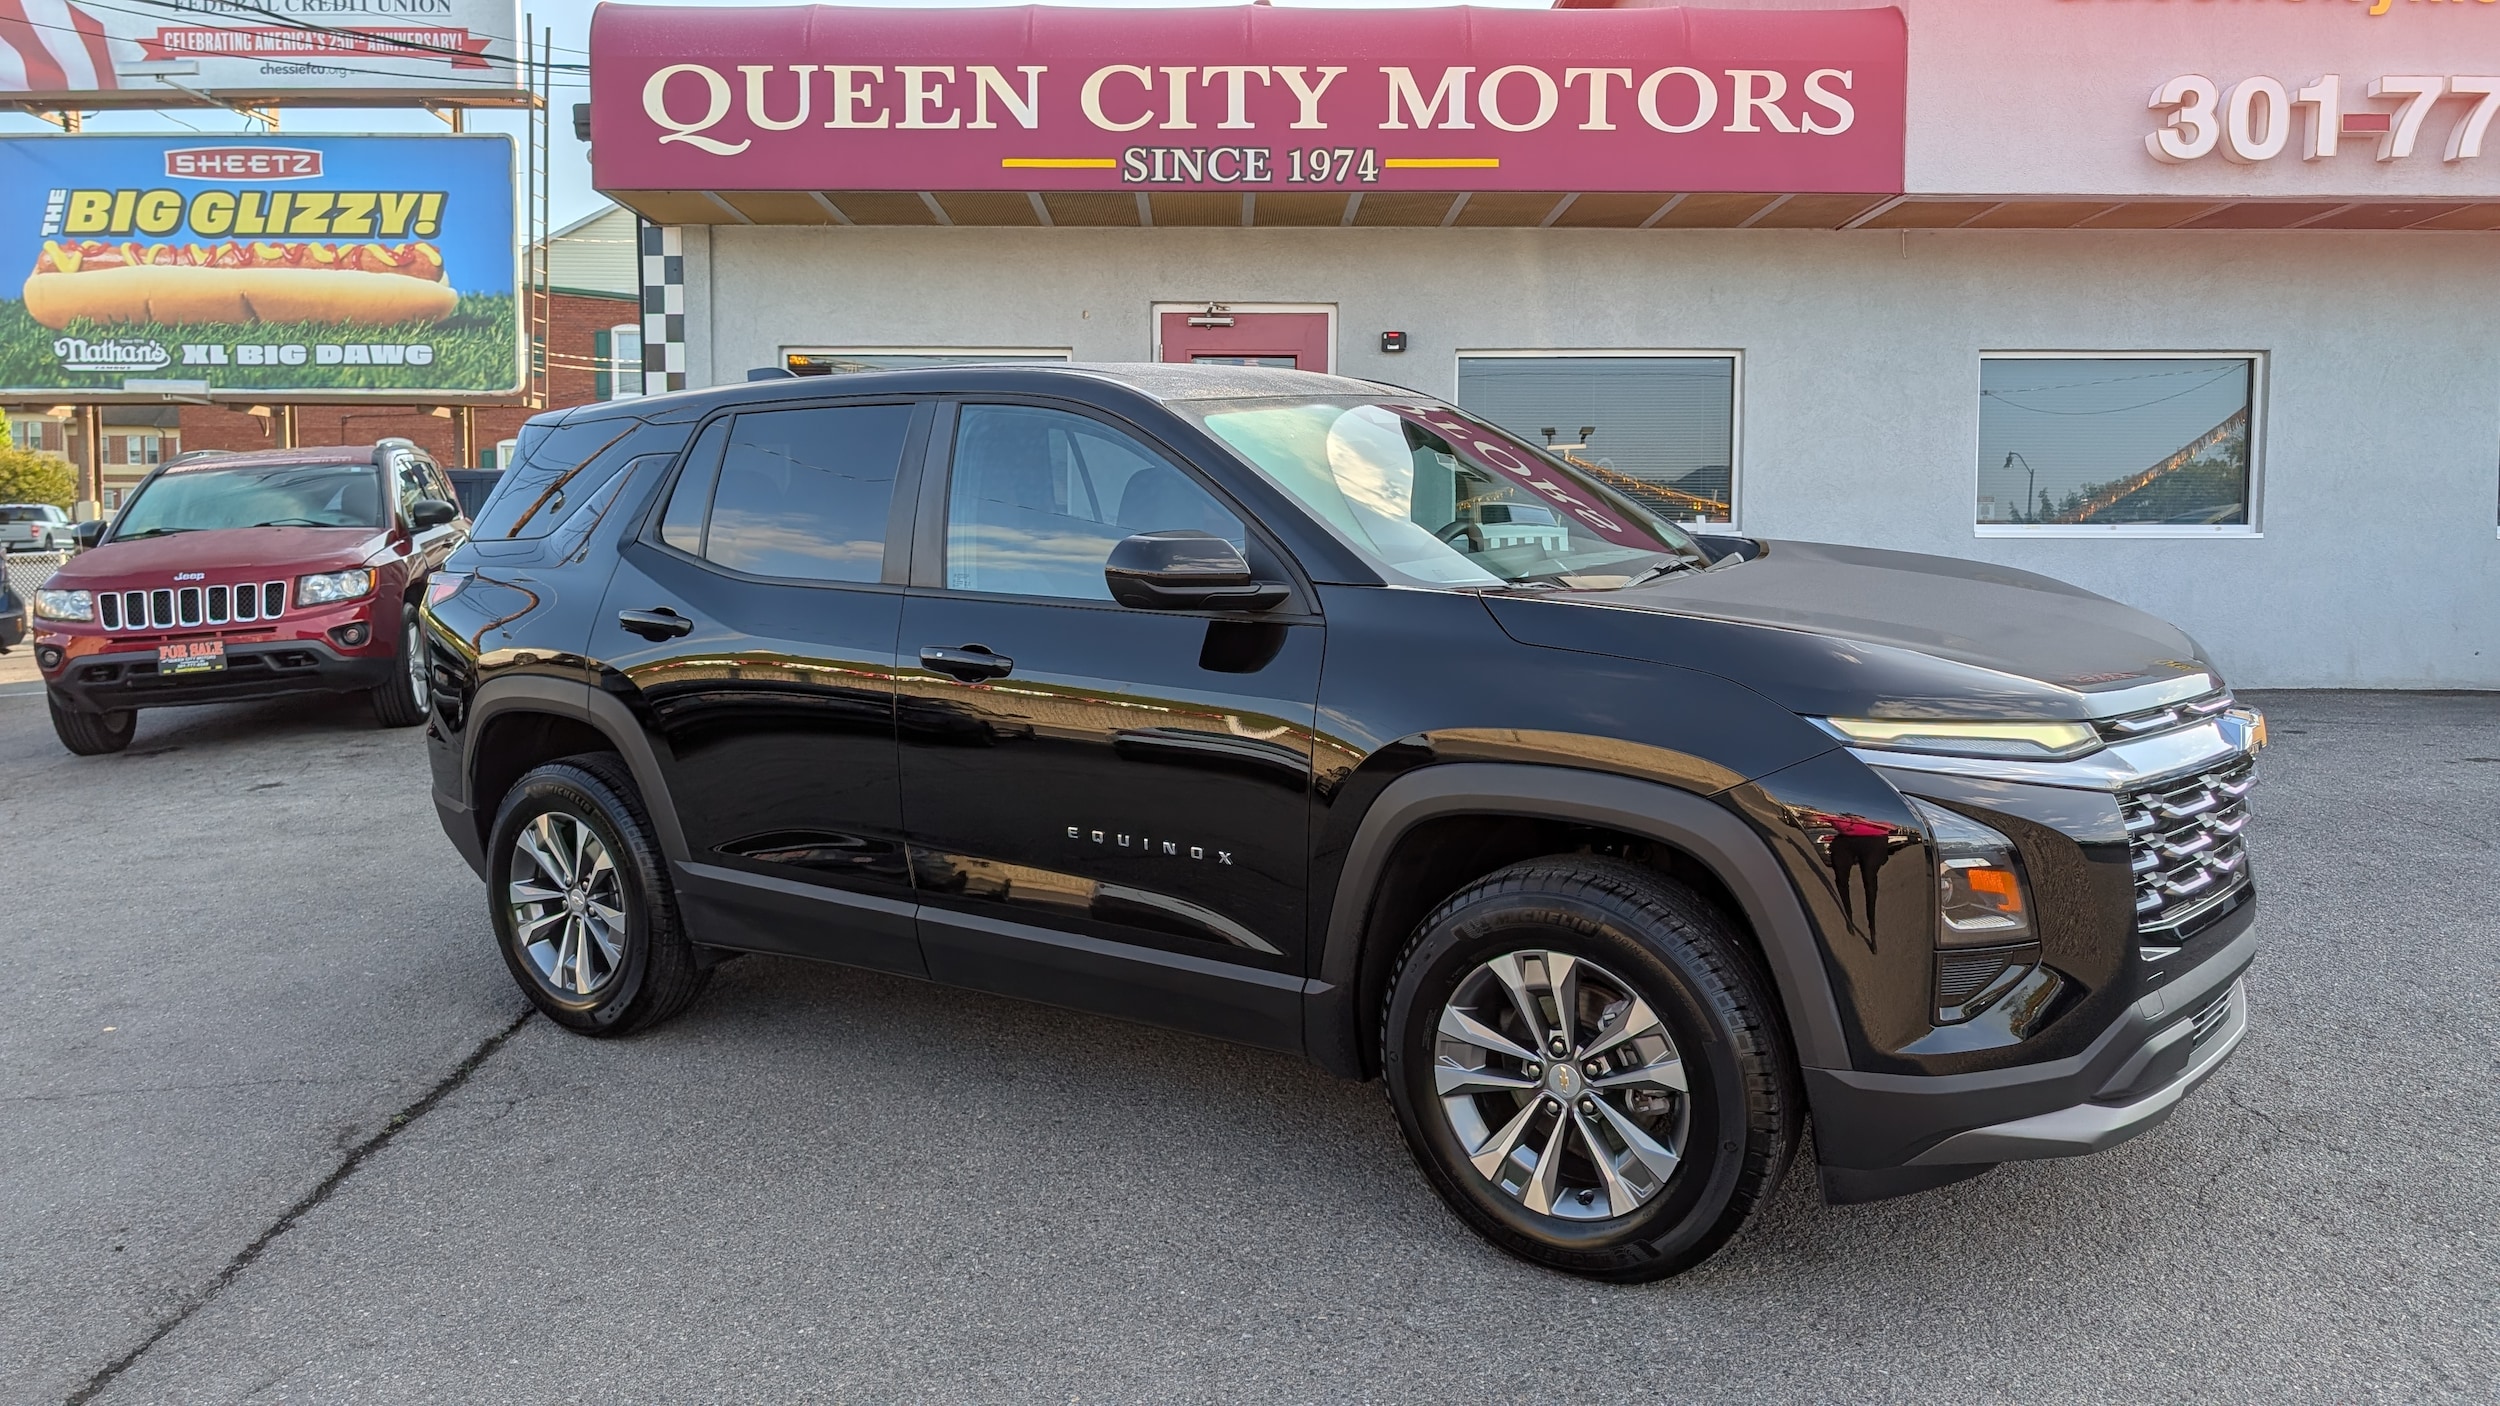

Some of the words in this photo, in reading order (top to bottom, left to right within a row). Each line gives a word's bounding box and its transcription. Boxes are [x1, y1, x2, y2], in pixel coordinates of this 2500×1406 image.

[377, 0, 452, 13] UNION
[163, 31, 253, 51] CELEBRATING
[255, 31, 326, 51] AMERICA'S
[259, 61, 347, 79] chessiefcu.org
[641, 63, 1049, 157] QUEEN
[1079, 64, 1348, 133] CITY
[1377, 64, 1856, 136] MOTORS
[2145, 73, 2500, 165] 301-77
[175, 154, 313, 174] SHEETZ
[1122, 147, 1273, 183] SINCE
[1287, 147, 1380, 183] 1974
[40, 188, 67, 237] THE
[64, 188, 183, 235] BIG
[188, 189, 445, 236] GLIZZY!
[53, 337, 171, 364] Nathan's
[181, 344, 229, 365] XL
[236, 344, 308, 366] BIG
[315, 344, 434, 366] DAWG
[173, 571, 205, 581] Jeep
[158, 643, 188, 660] FOR
[189, 641, 224, 657] SALE
[1067, 826, 1233, 866] EQUINOX
